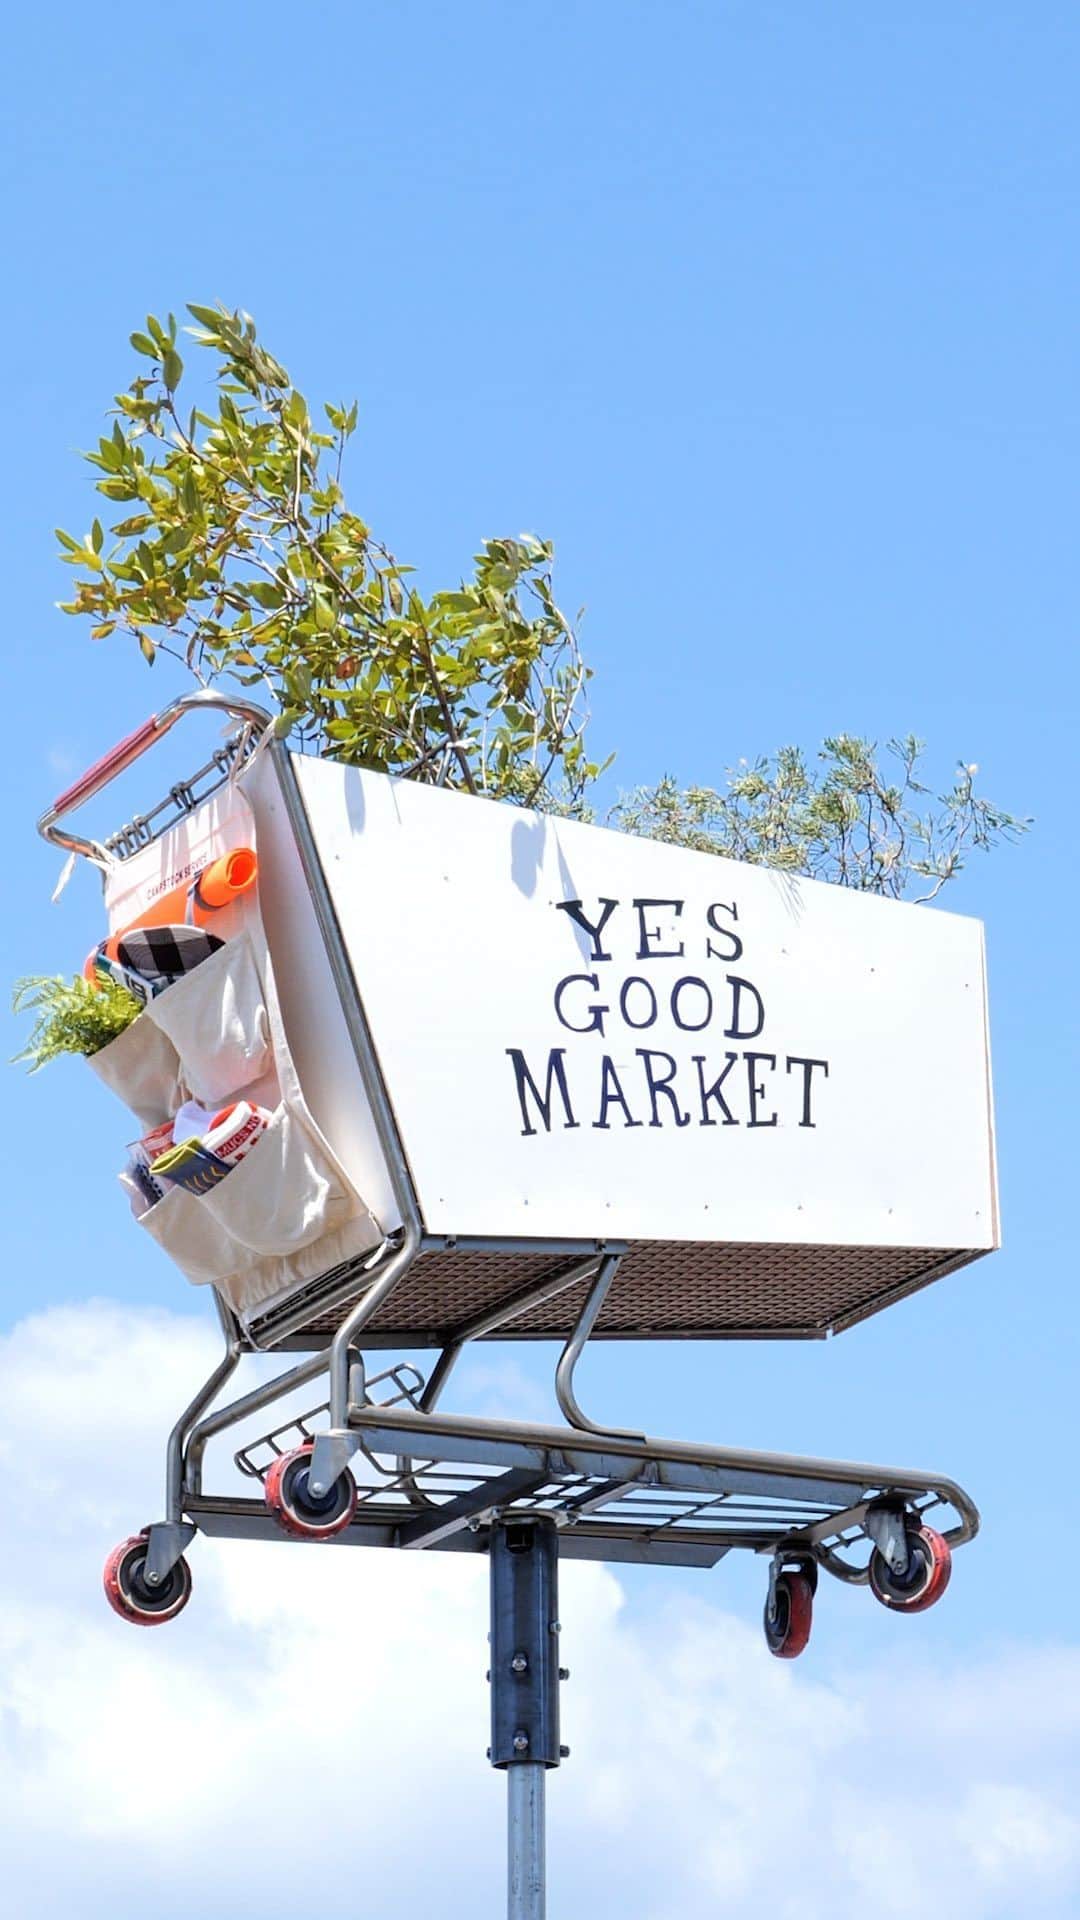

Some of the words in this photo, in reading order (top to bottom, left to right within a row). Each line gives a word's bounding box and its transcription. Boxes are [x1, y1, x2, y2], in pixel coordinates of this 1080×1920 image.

[556, 897, 743, 962] YES
[554, 973, 765, 1040] GOOD
[505, 1048, 829, 1136] MARKET
